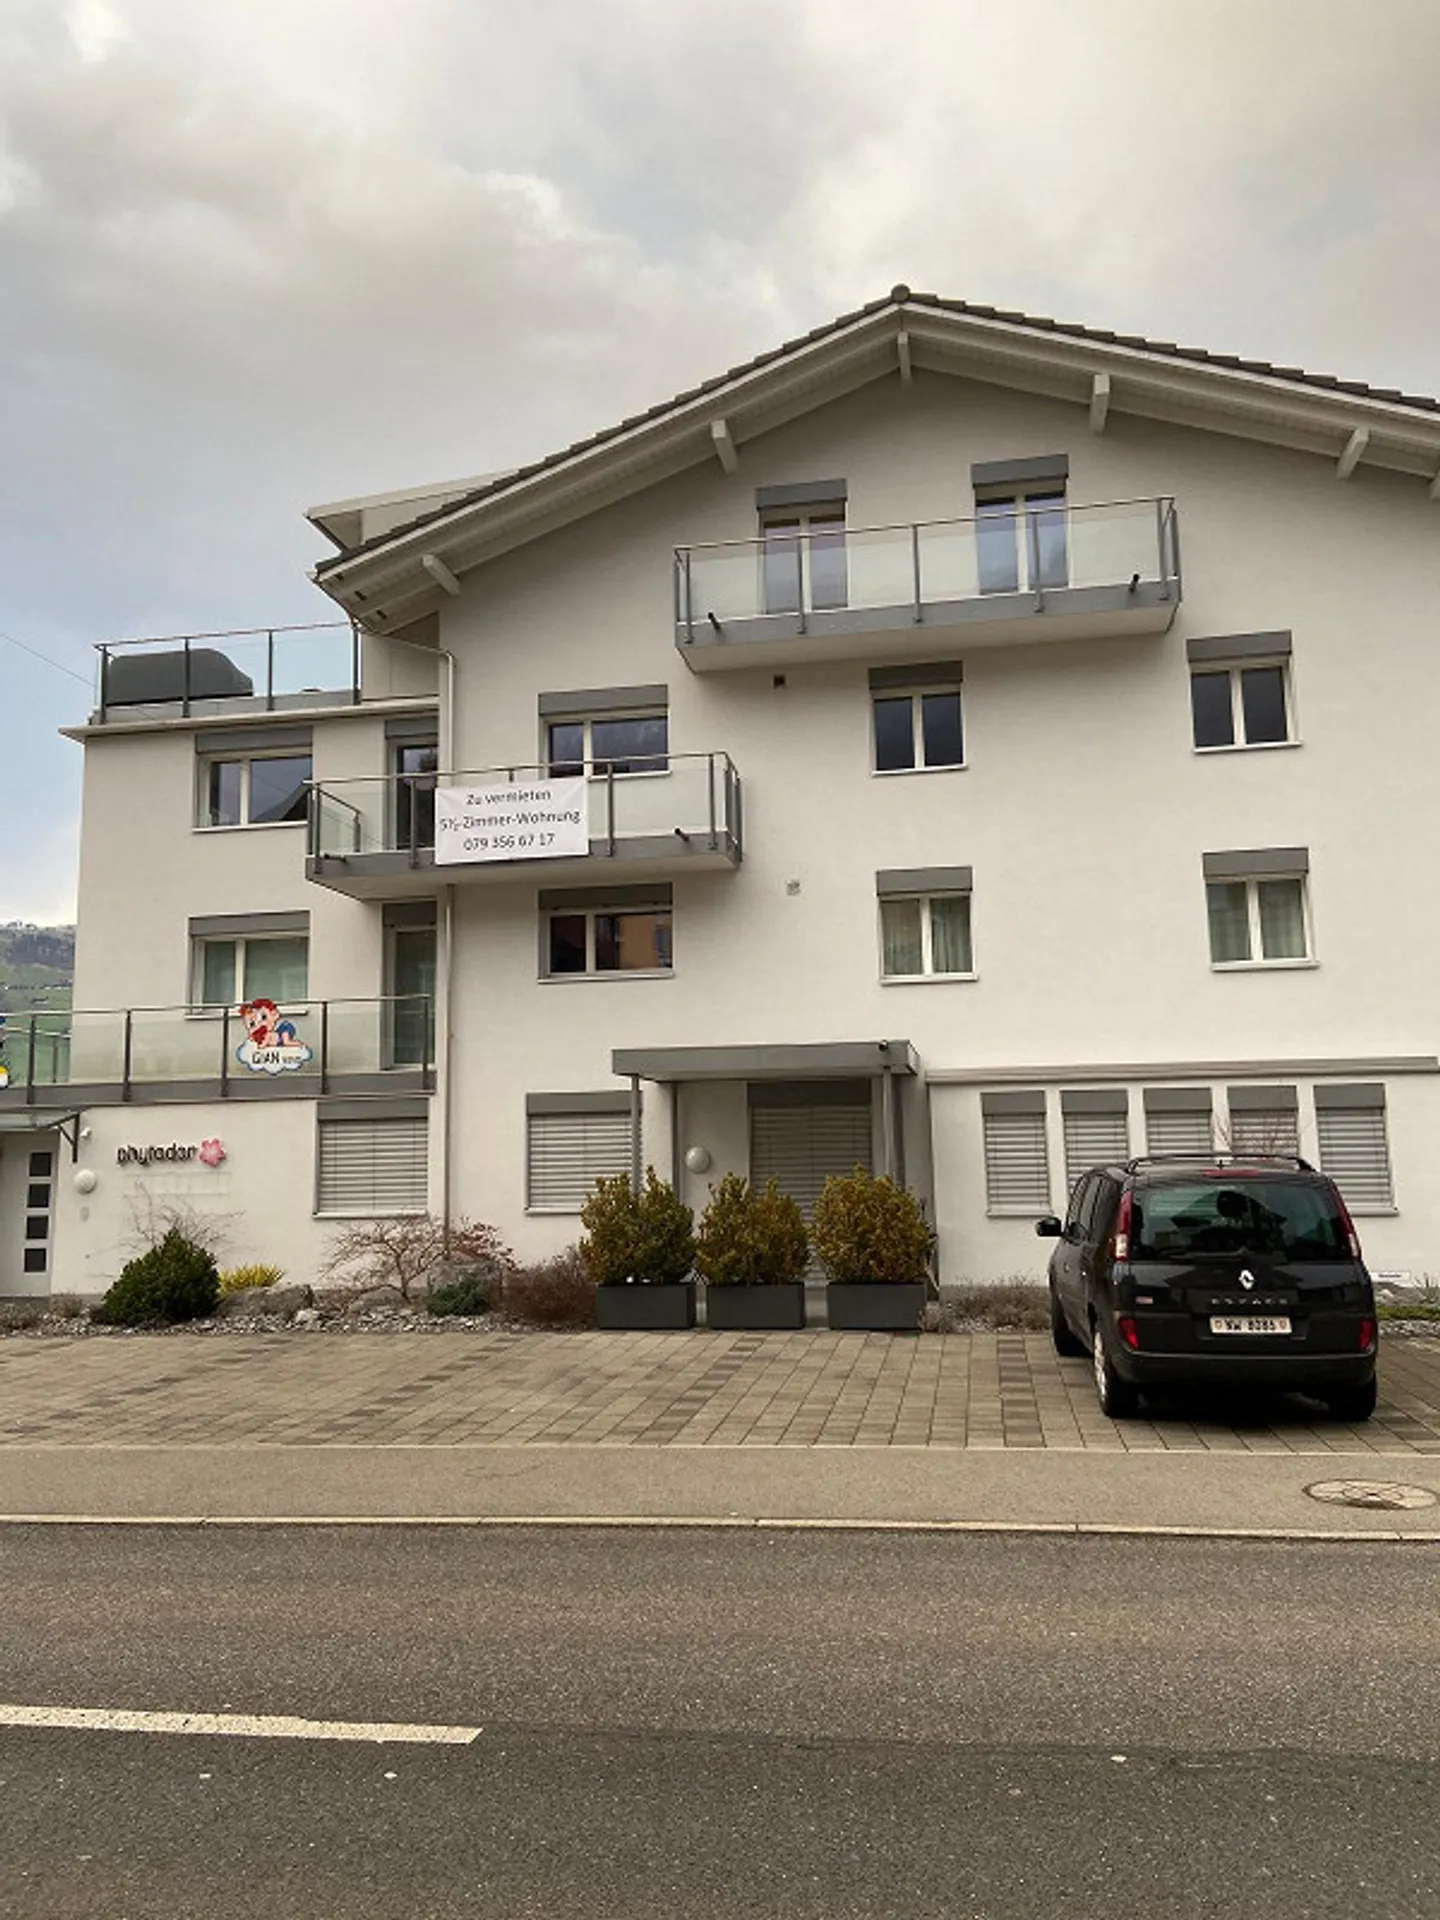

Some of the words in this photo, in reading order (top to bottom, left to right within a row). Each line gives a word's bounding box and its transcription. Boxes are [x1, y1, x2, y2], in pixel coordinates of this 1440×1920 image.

[466, 794, 482, 805] Zu
[485, 789, 551, 804] vermieten
[463, 837, 489, 851] 079
[492, 835, 515, 848] 356
[518, 834, 535, 847] 67
[539, 832, 555, 846] 17
